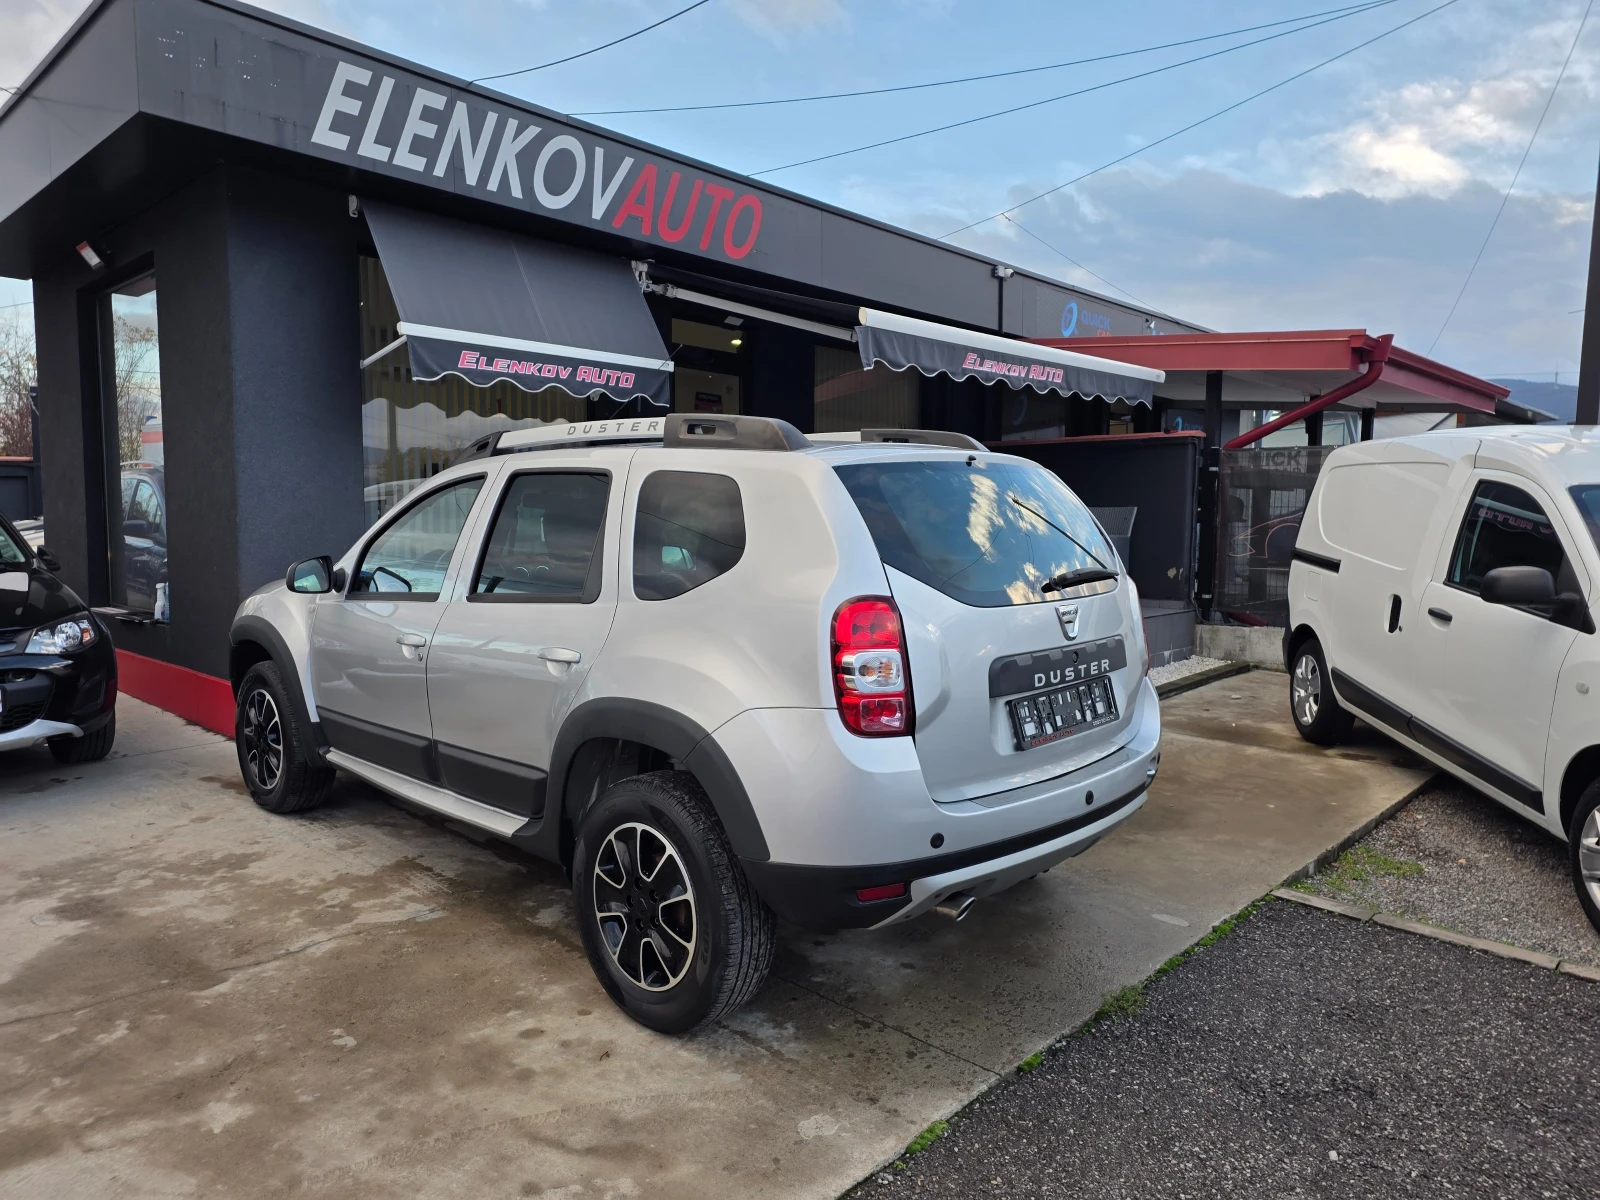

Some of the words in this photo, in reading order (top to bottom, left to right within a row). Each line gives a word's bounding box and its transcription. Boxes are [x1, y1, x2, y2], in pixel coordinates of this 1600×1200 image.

[457, 350, 573, 379] ELENKOV
[576, 365, 635, 388] AUTO
[962, 352, 1028, 377] ELENKOV
[1029, 364, 1064, 383] AUTO
[567, 421, 659, 435] DUSTER
[1034, 658, 1110, 688] DUSTER
